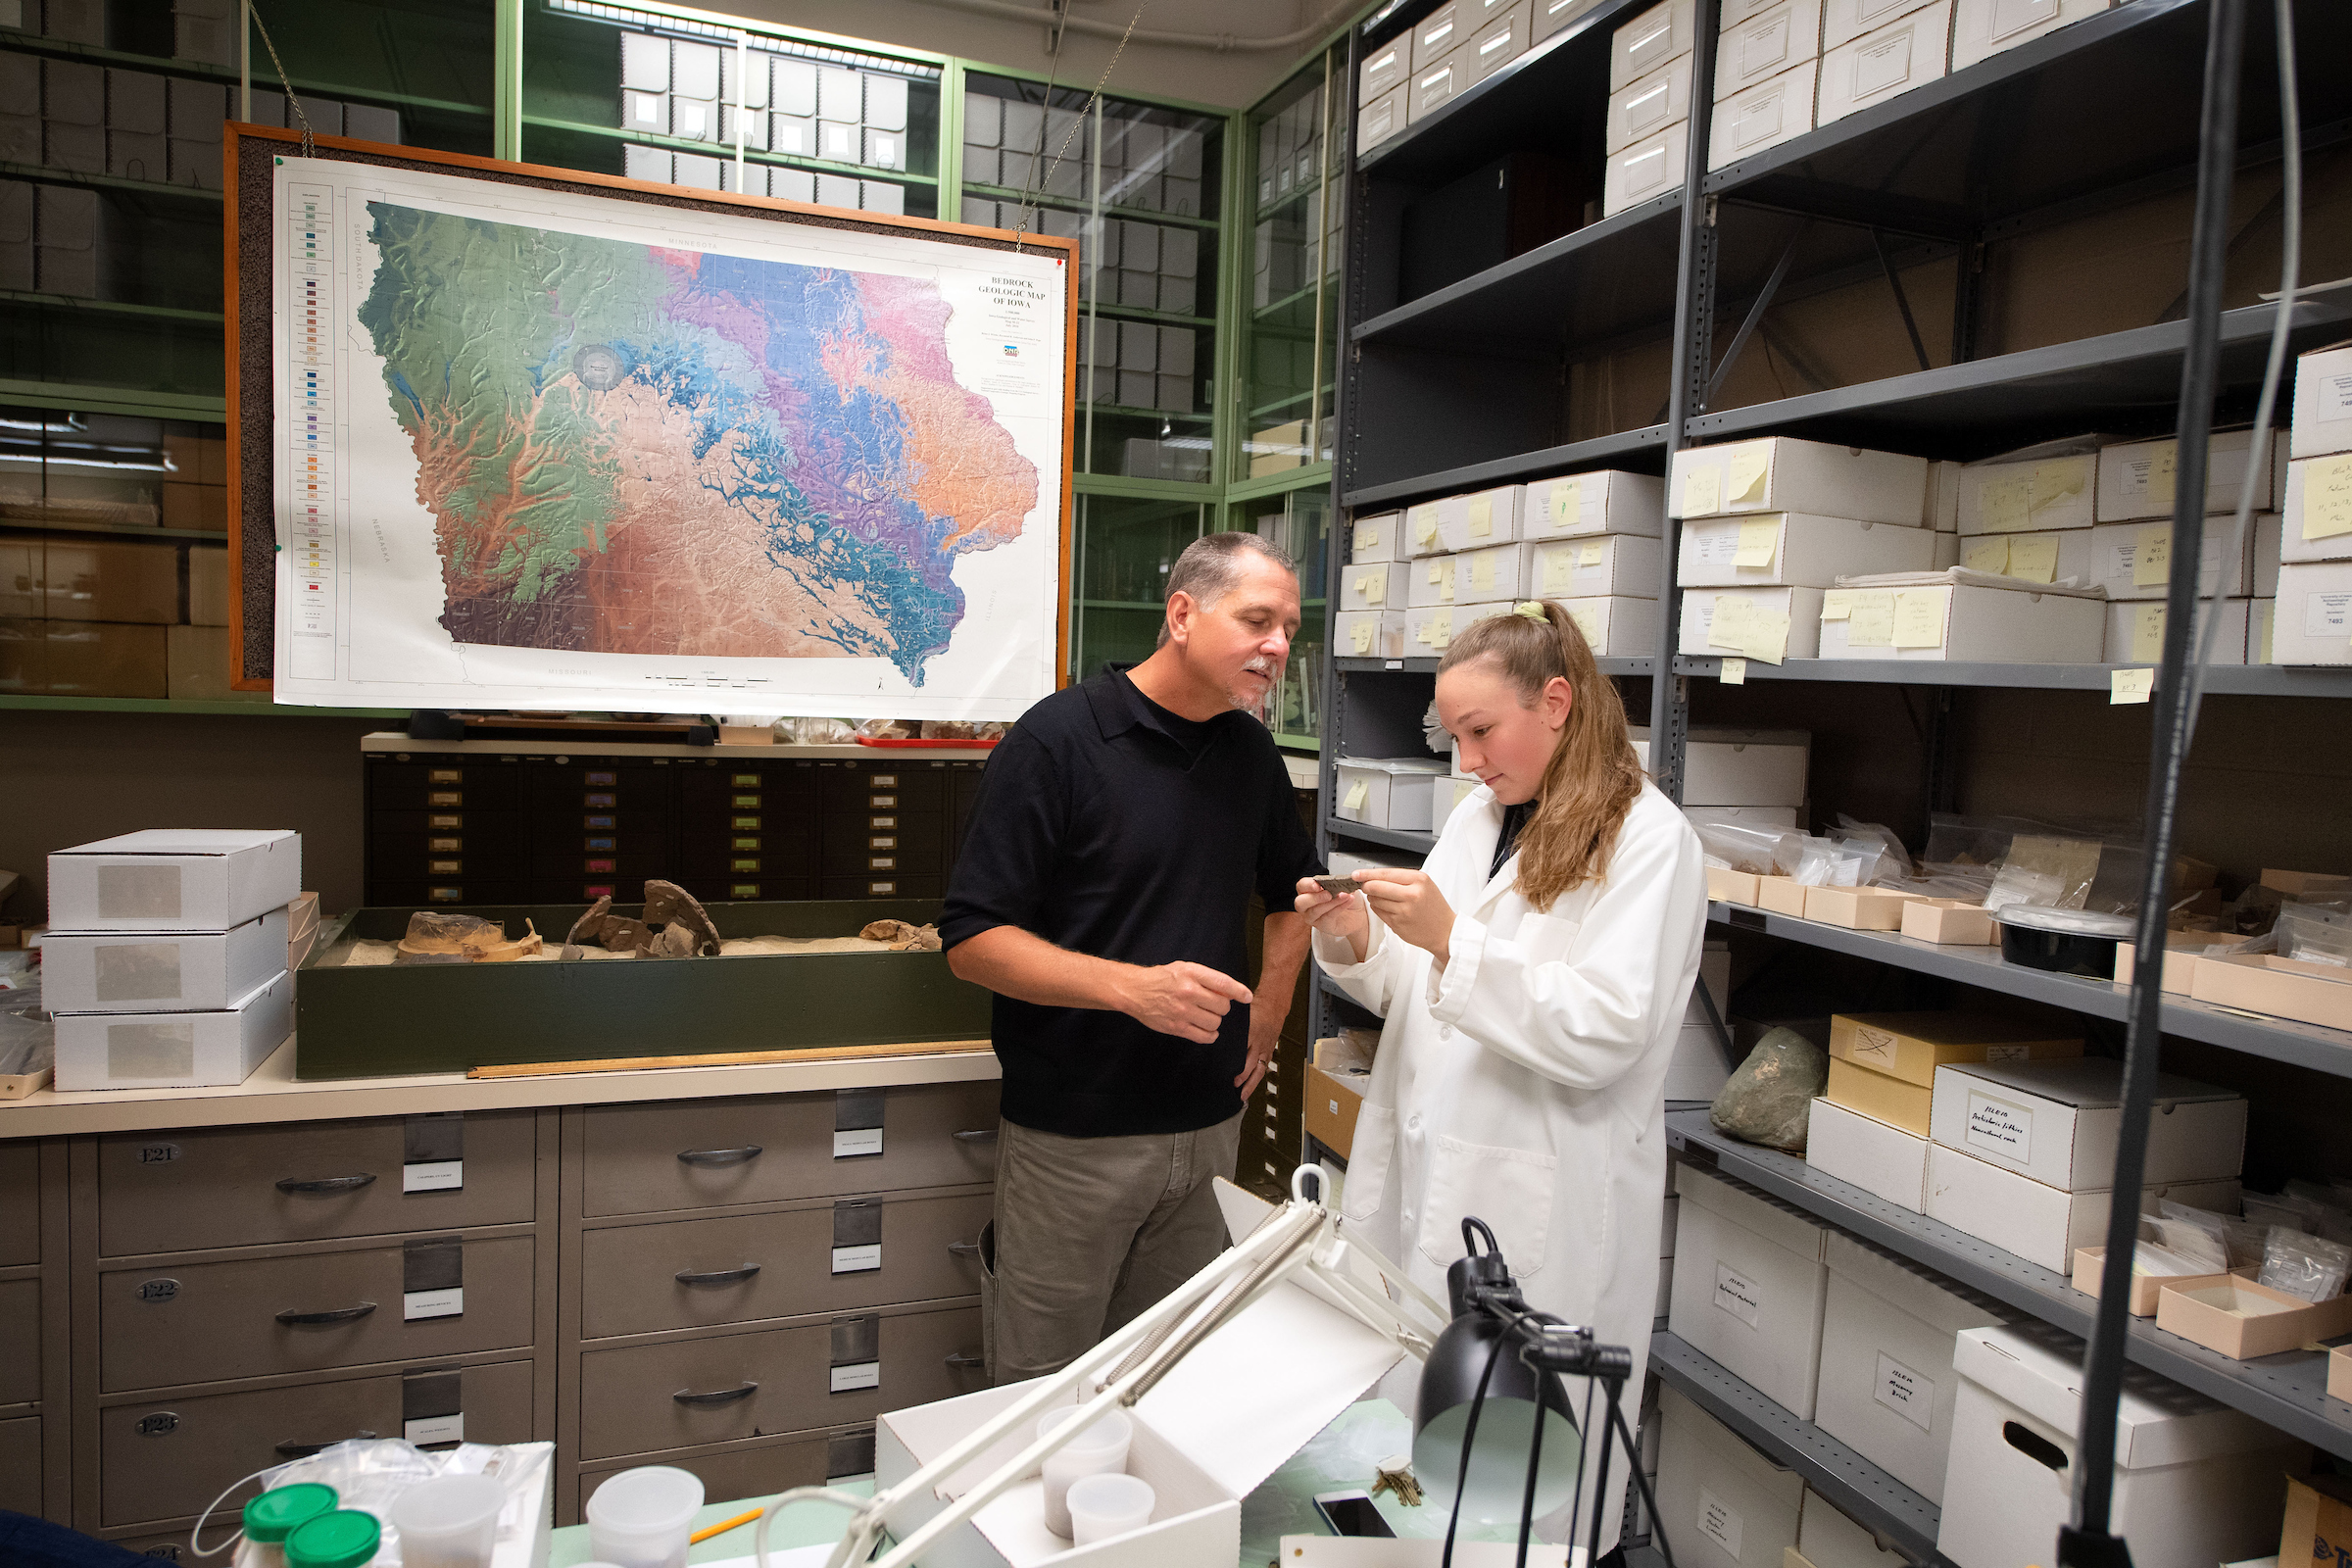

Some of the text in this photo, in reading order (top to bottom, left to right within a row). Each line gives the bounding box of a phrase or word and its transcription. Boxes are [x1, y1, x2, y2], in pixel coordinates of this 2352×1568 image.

[668, 237, 717, 249] MINNESOTA
[355, 256, 364, 290] DAKOTA
[992, 276, 1034, 289] BEDROCK
[978, 285, 1046, 300] GEOLOGIC MAP
[1007, 298, 1031, 309] IOWA
[372, 518, 390, 564] NEBRASKA
[143, 1148, 172, 1162] E21
[143, 1284, 174, 1298] E22
[143, 1417, 174, 1434] E23
